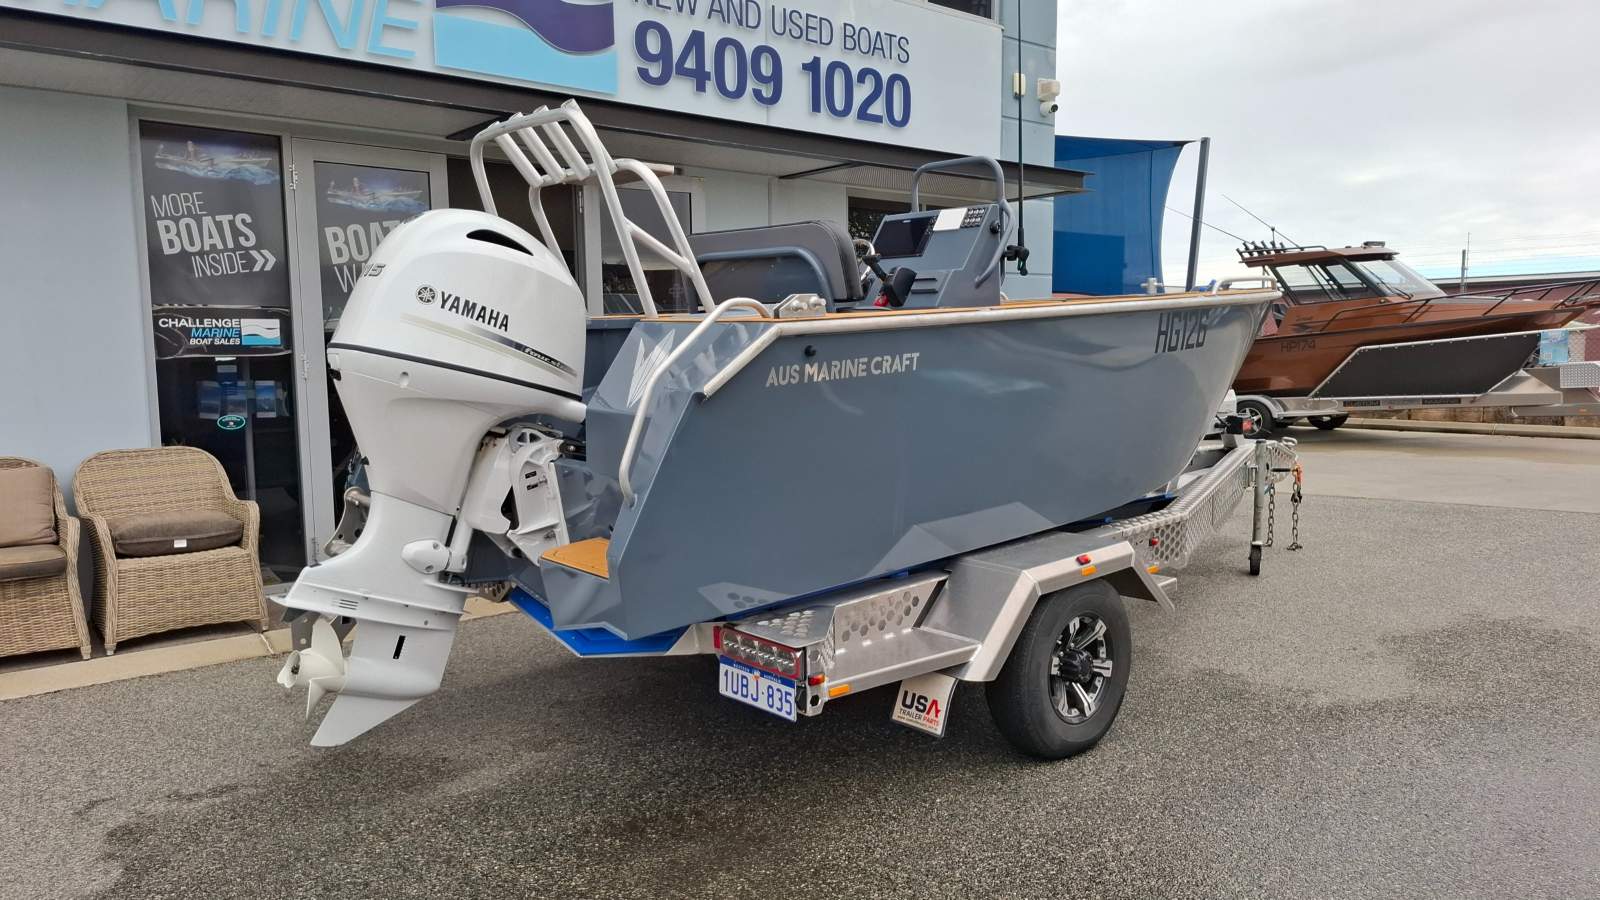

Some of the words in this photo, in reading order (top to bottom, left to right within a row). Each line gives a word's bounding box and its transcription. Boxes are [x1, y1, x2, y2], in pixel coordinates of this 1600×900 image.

[708, 0, 761, 30] AND
[771, 5, 834, 47] USED
[843, 22, 910, 64] BOATS
[634, 20, 783, 107] 9409
[801, 55, 912, 128] 1020
[150, 191, 208, 218] MORE
[157, 213, 257, 255] BOATS
[191, 250, 250, 278] INSIDE
[158, 318, 241, 328] CHALLENGE
[440, 291, 510, 332] YAMAHA
[191, 327, 240, 338] MARINE
[766, 364, 800, 388] AUS
[804, 357, 868, 384] MARINE
[870, 352, 920, 374] CRAFT
[901, 690, 941, 718] USA
